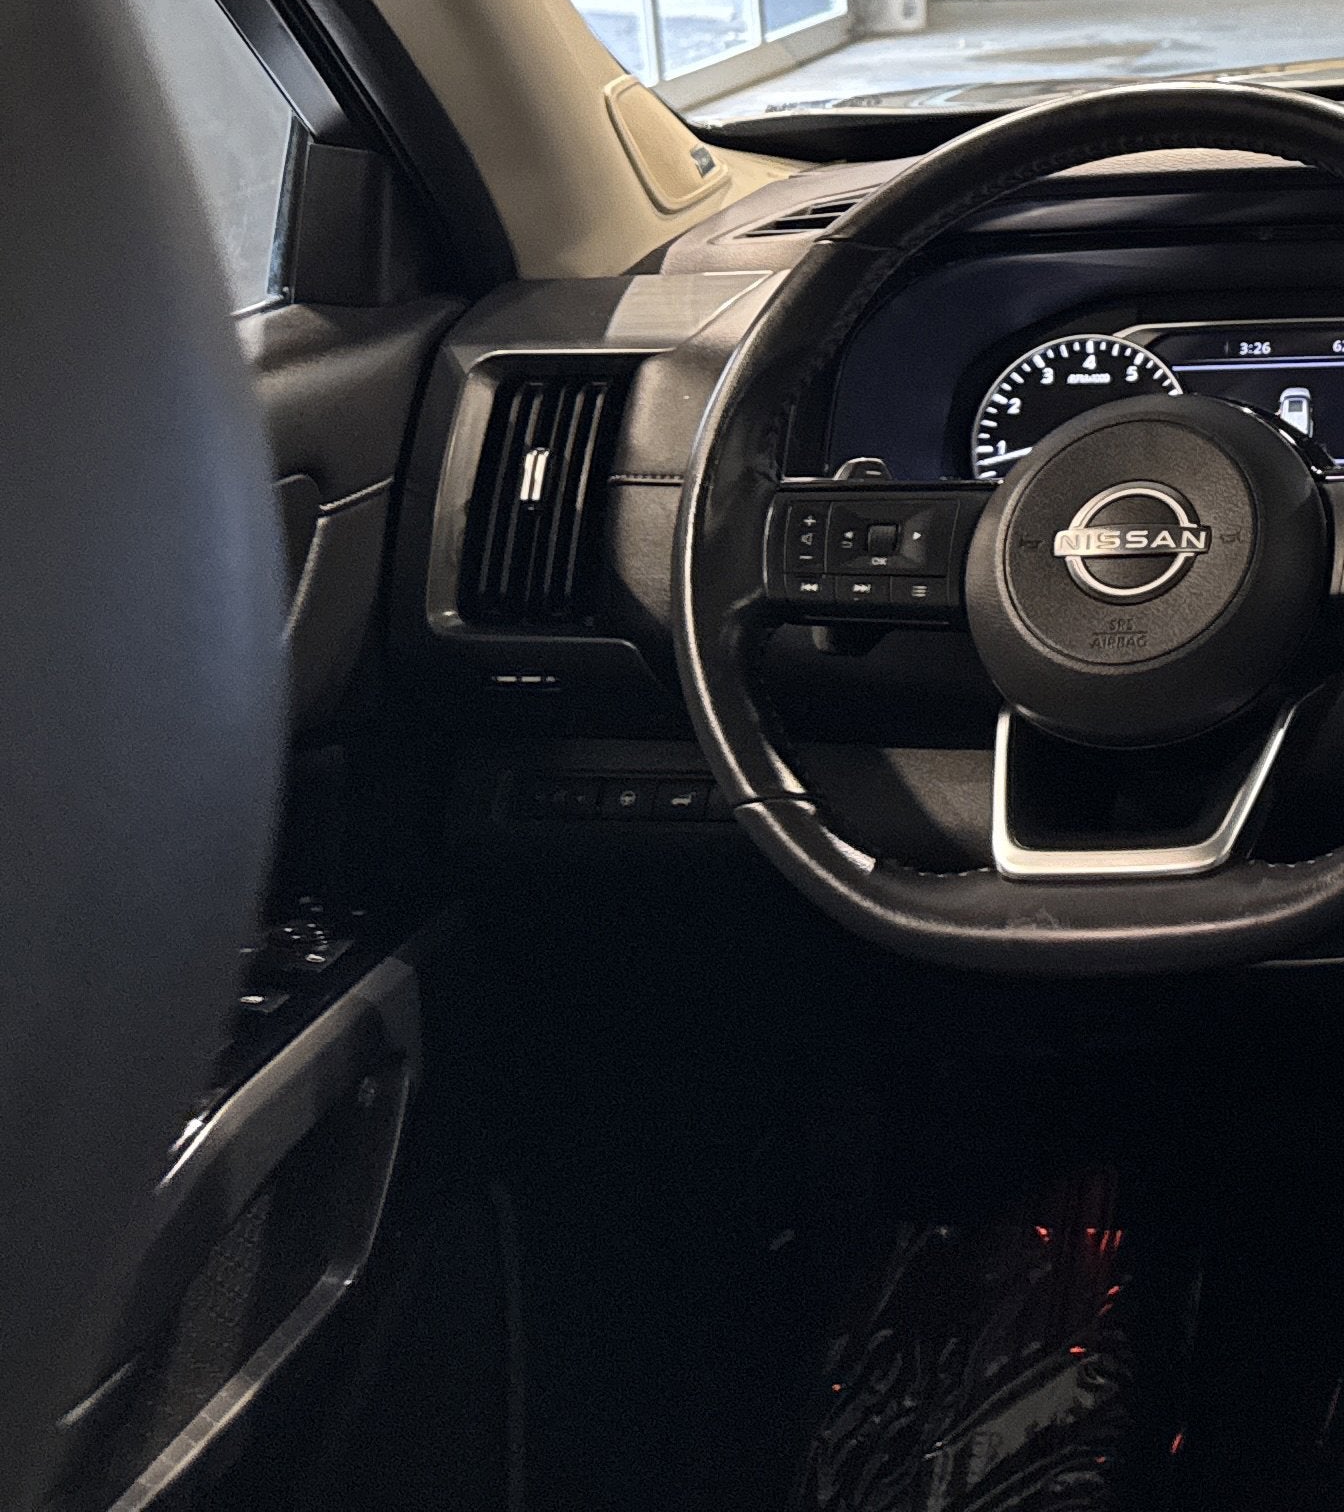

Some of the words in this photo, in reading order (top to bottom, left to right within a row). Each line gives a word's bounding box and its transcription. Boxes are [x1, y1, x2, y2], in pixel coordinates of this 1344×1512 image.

[1238, 341, 1272, 355] 3:26
[1082, 354, 1097, 370] 4
[1040, 367, 1054, 384] 3
[1124, 365, 1138, 382] 5
[1006, 397, 1022, 414] 2
[997, 440, 1006, 455] 1
[1060, 530, 1206, 551] NISSAN
[871, 557, 888, 566] OK
[1109, 618, 1134, 631] SRS
[1090, 636, 1148, 649] AIRBAG
